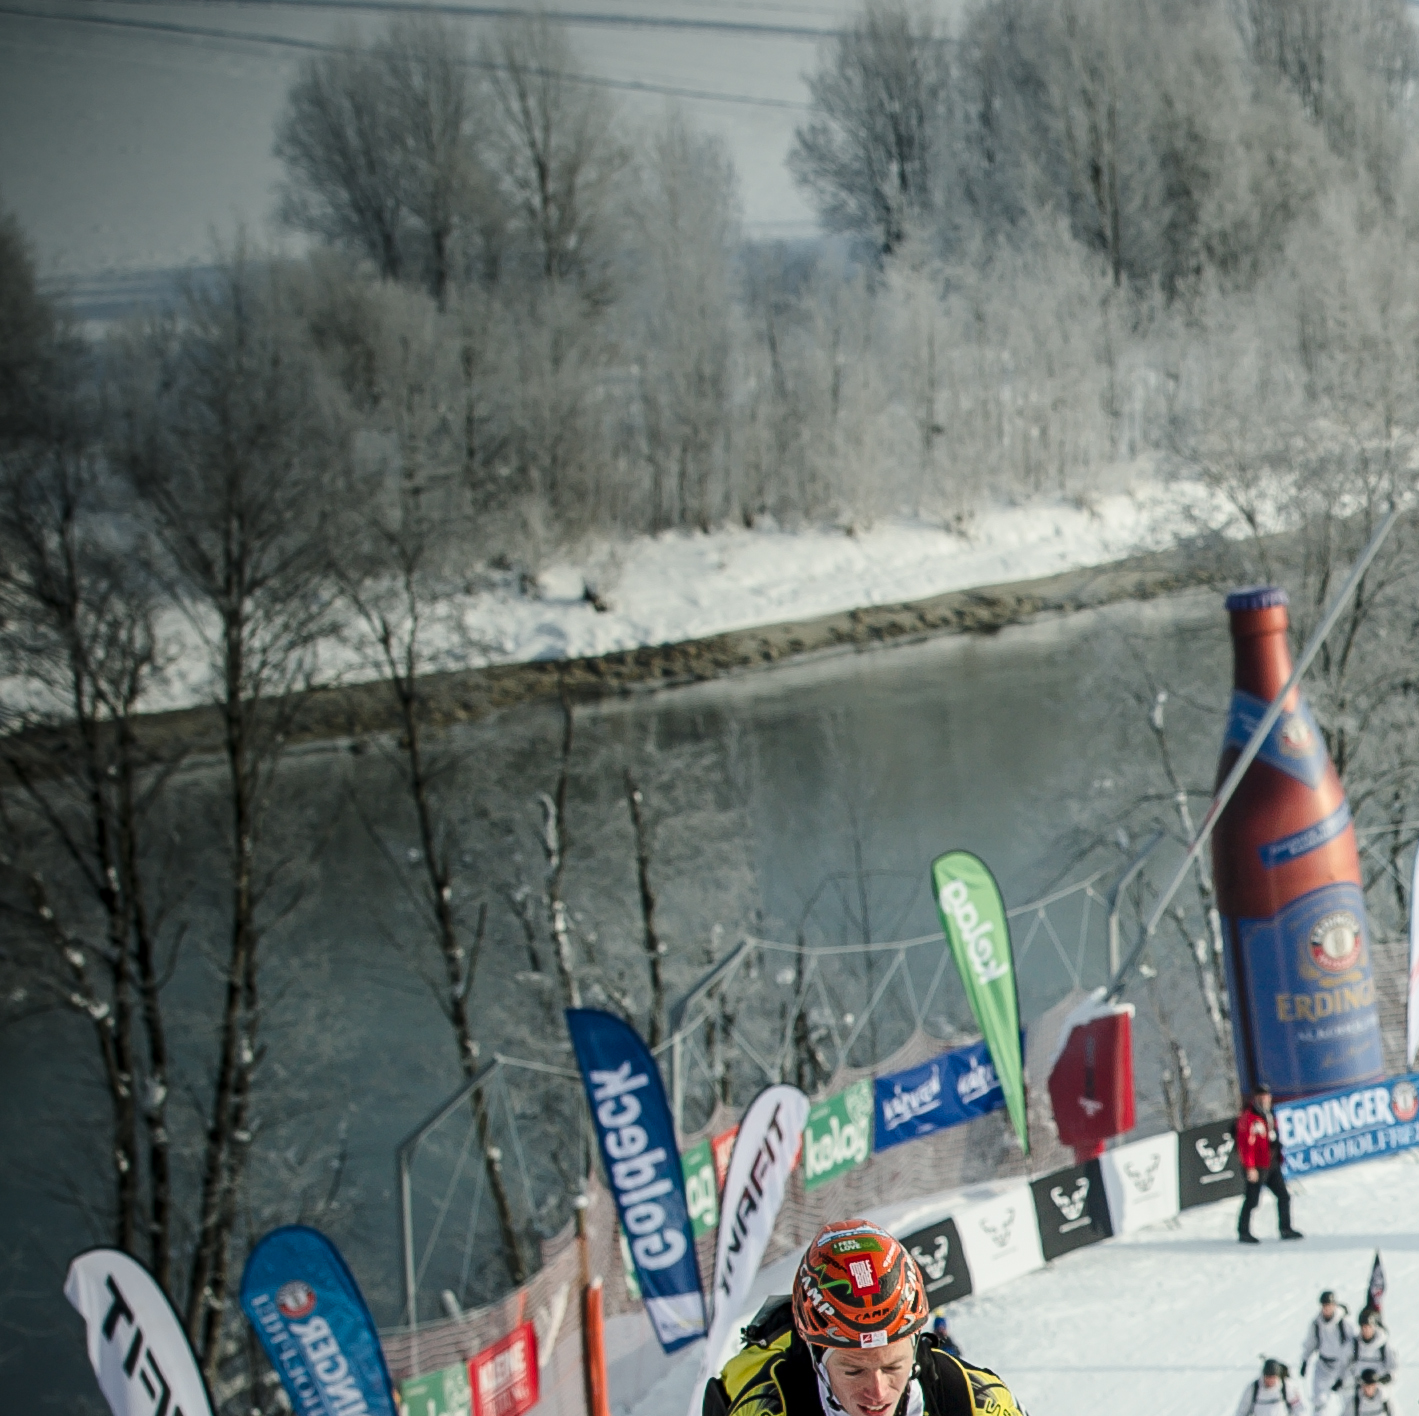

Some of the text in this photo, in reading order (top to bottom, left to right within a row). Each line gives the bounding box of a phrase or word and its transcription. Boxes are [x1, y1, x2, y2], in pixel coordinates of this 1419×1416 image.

[806, 1114, 871, 1179] kelag
[1279, 1087, 1395, 1147] ERDINGER
[854, 1308, 891, 1322] CAMP
